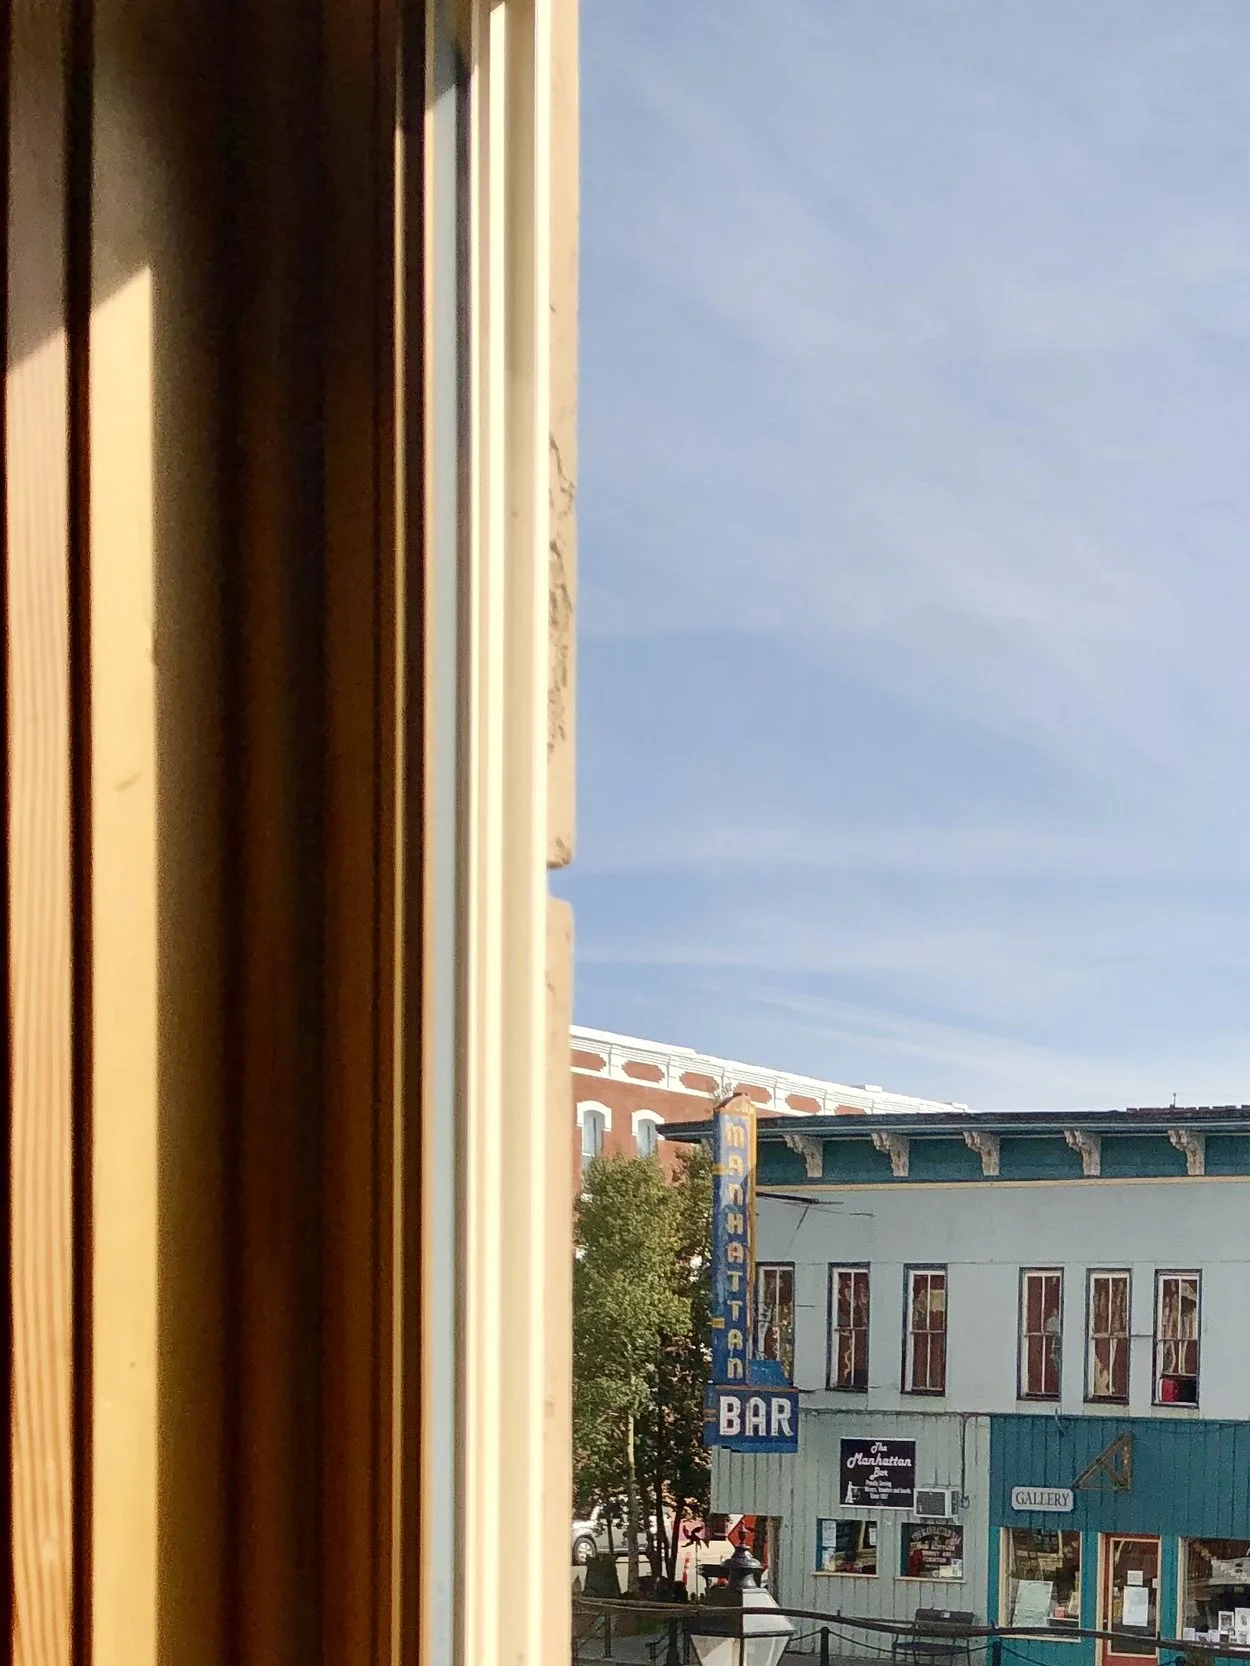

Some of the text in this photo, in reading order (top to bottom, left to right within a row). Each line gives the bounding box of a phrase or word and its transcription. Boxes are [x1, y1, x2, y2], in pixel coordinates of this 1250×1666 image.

[726, 1122, 745, 1380] MANHATTAN
[719, 1395, 794, 1438] BAR
[870, 1442, 888, 1454] The
[846, 1452, 912, 1469] Manhattan
[869, 1466, 888, 1480] Bar
[1015, 1491, 1070, 1507] GALLERY
